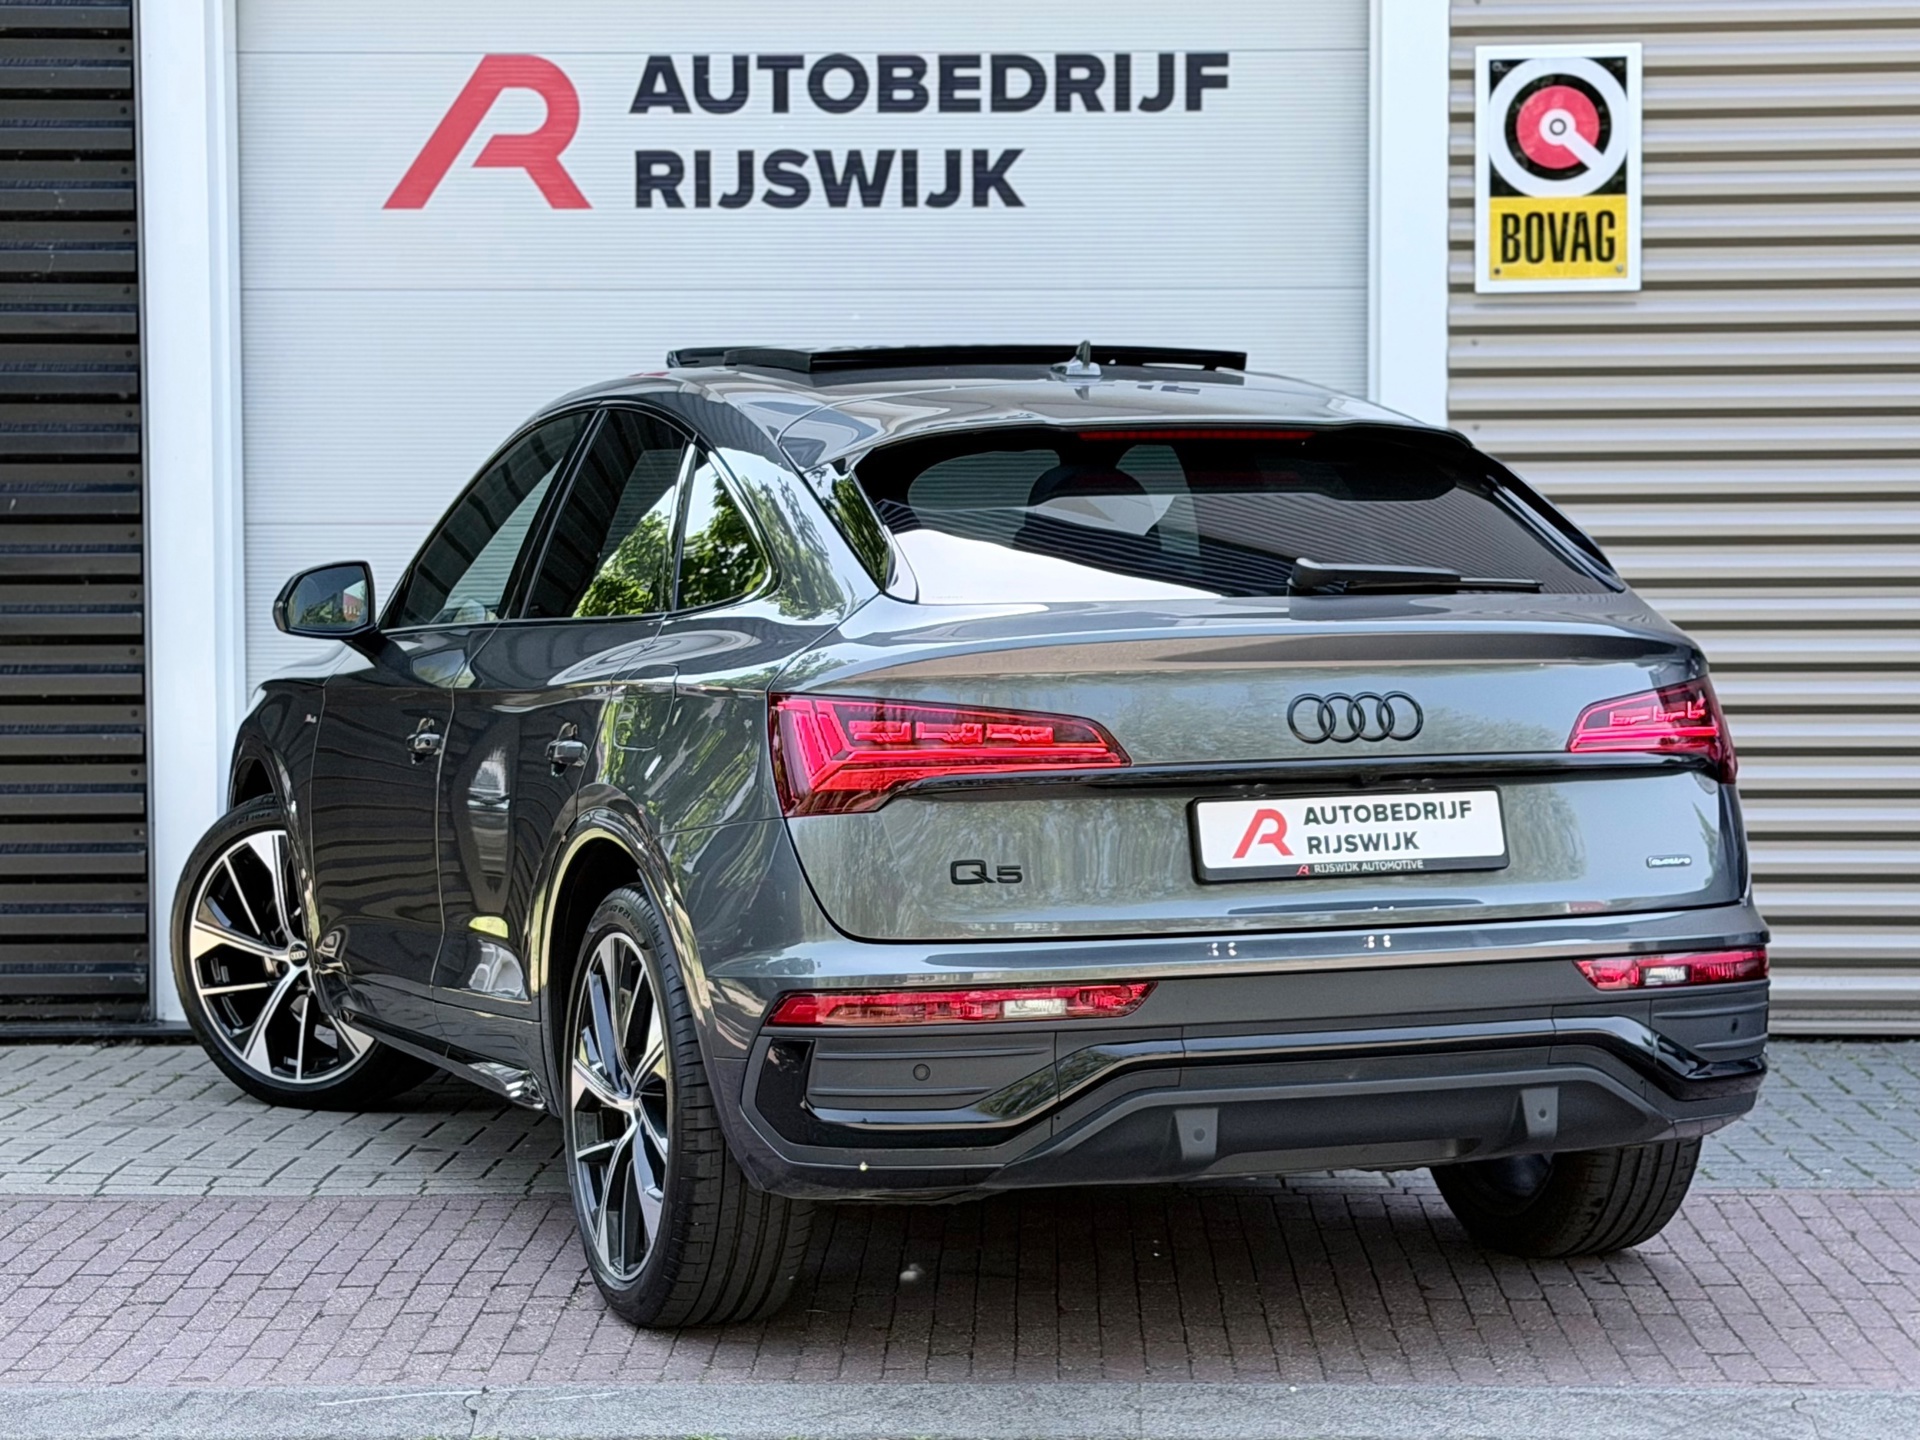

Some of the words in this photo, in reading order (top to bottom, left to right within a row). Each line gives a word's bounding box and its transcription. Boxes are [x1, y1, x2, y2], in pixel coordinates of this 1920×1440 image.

[630, 53, 1229, 114] AUTOBEDRIJF
[634, 149, 1026, 208] RIJSWIJK
[1501, 210, 1616, 264] BOVAG
[1303, 800, 1472, 826] AUTOBEDRIJF
[1307, 831, 1420, 855] RIJSWIJK
[950, 859, 1023, 885] Q5
[1314, 863, 1360, 874] RIJSWIJK
[1361, 860, 1424, 872] AUTOMOTIVE
